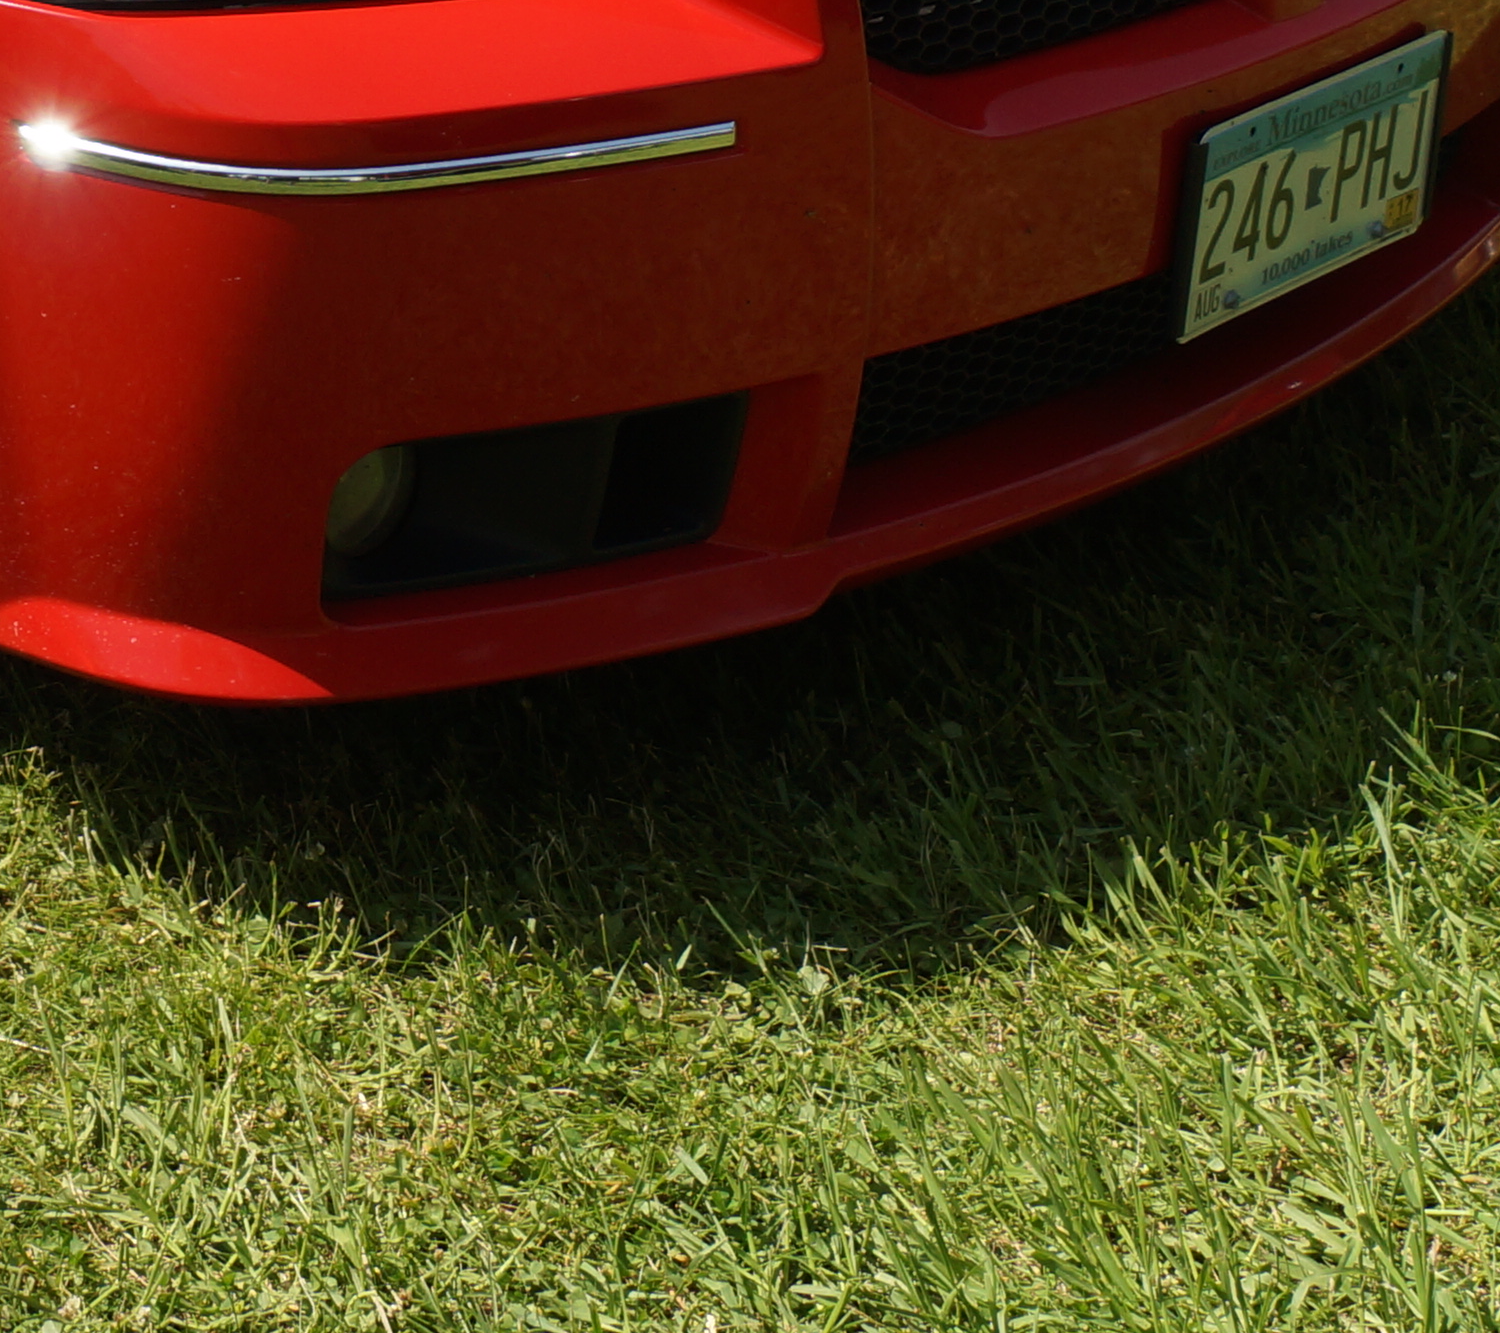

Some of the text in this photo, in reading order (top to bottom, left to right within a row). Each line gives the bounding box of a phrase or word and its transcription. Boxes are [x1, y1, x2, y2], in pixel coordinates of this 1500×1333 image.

[1198, 89, 1430, 285] 246 PHJ
[1315, 231, 1354, 260] lakes
[1193, 282, 1222, 323] AUG
